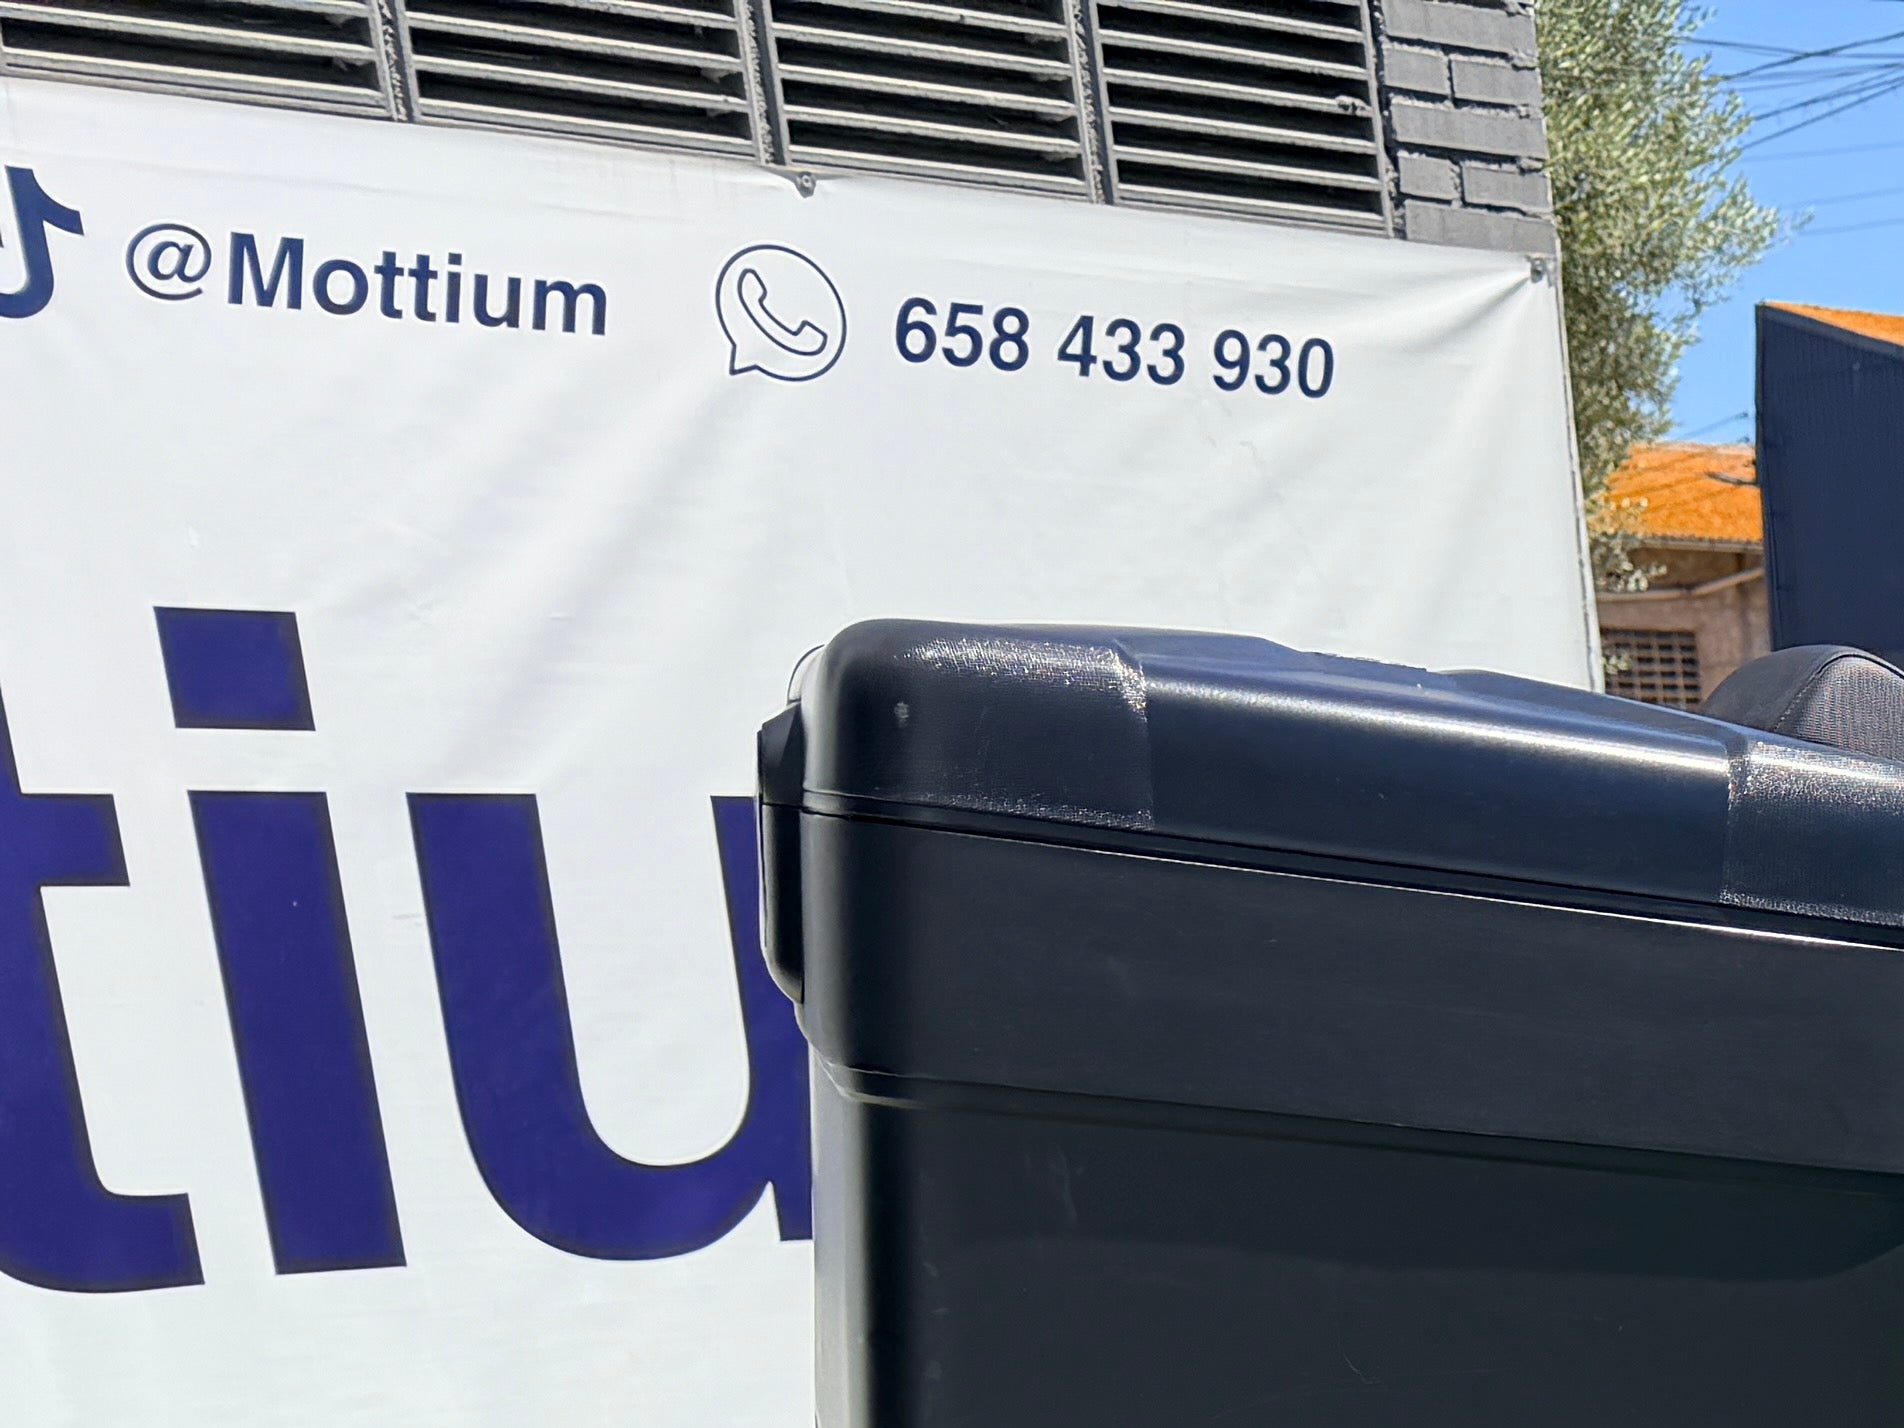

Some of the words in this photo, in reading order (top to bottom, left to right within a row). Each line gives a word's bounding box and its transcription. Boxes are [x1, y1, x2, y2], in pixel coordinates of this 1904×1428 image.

[127, 222, 608, 336] @Mottium
[895, 297, 1030, 372] 658
[1056, 315, 1186, 385] 433
[1212, 328, 1335, 399] 930
